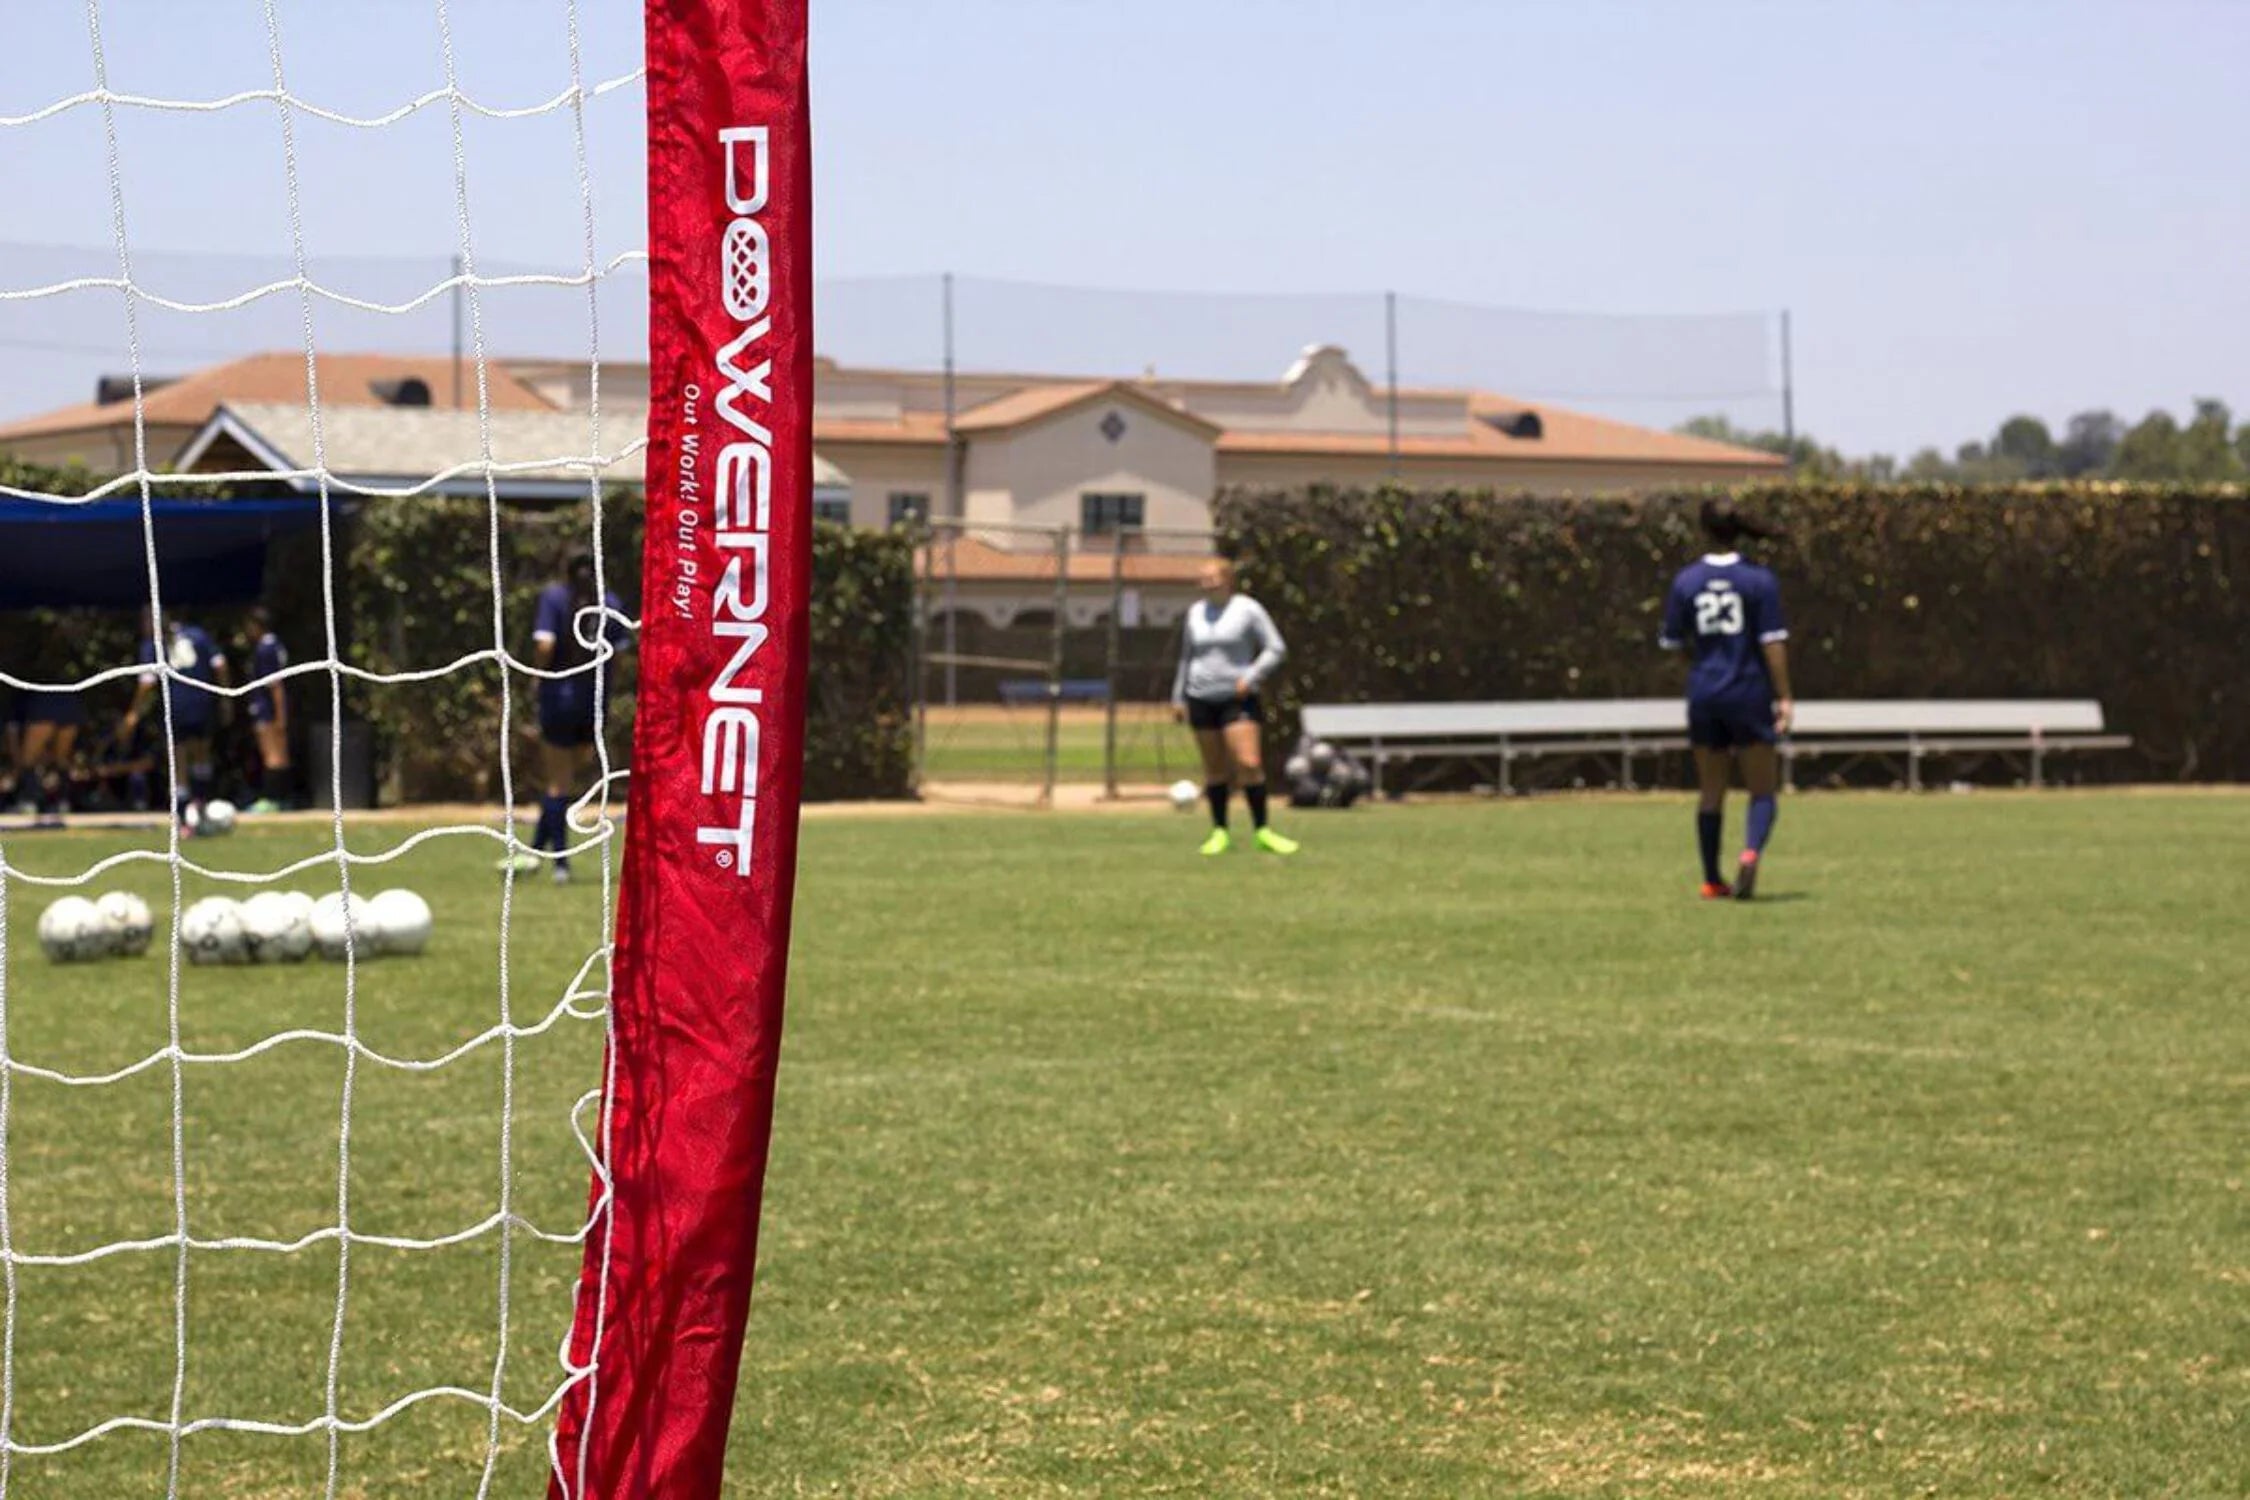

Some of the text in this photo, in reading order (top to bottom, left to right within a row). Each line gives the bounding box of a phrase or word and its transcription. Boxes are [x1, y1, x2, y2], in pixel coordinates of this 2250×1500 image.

[672, 383, 701, 619] Out Work! Out Play!
[696, 126, 773, 877] POWERNET
[1694, 592, 1743, 634] 23
